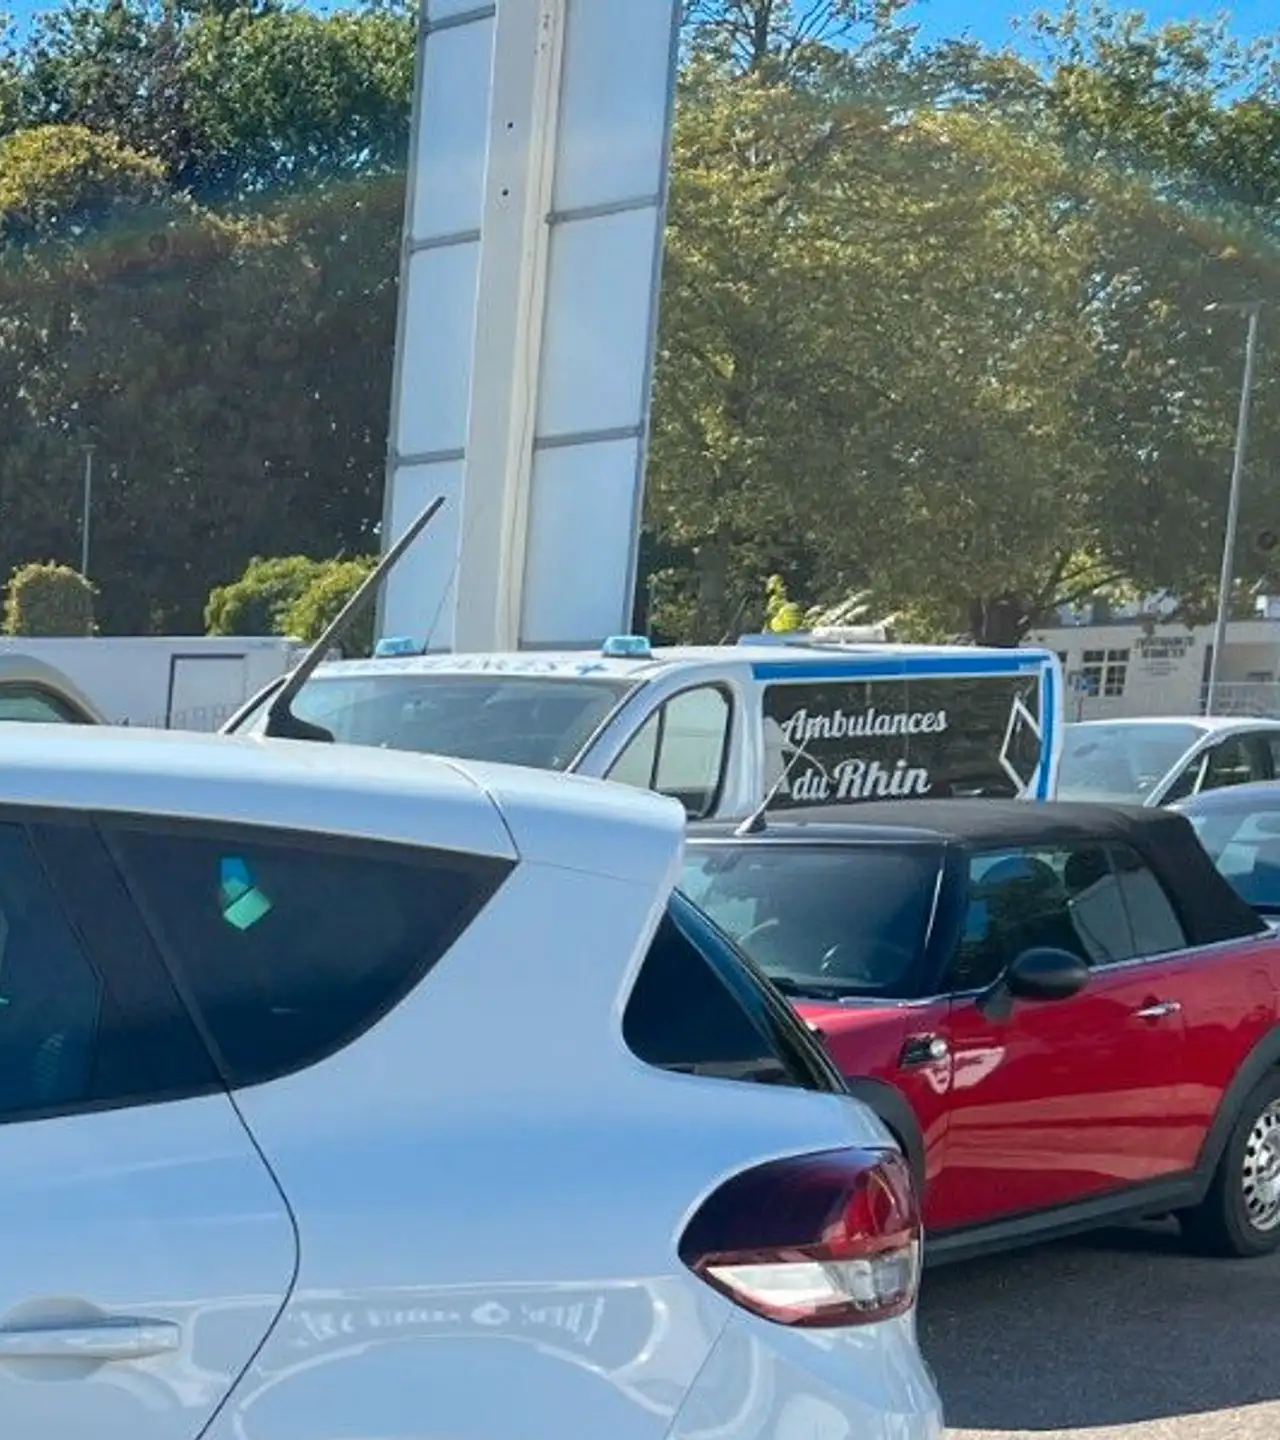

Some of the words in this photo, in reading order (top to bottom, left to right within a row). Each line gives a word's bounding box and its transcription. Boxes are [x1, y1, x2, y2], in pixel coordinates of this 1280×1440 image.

[781, 708, 948, 742] Ambulances
[792, 768, 830, 800] du
[831, 758, 932, 799] Rhin
